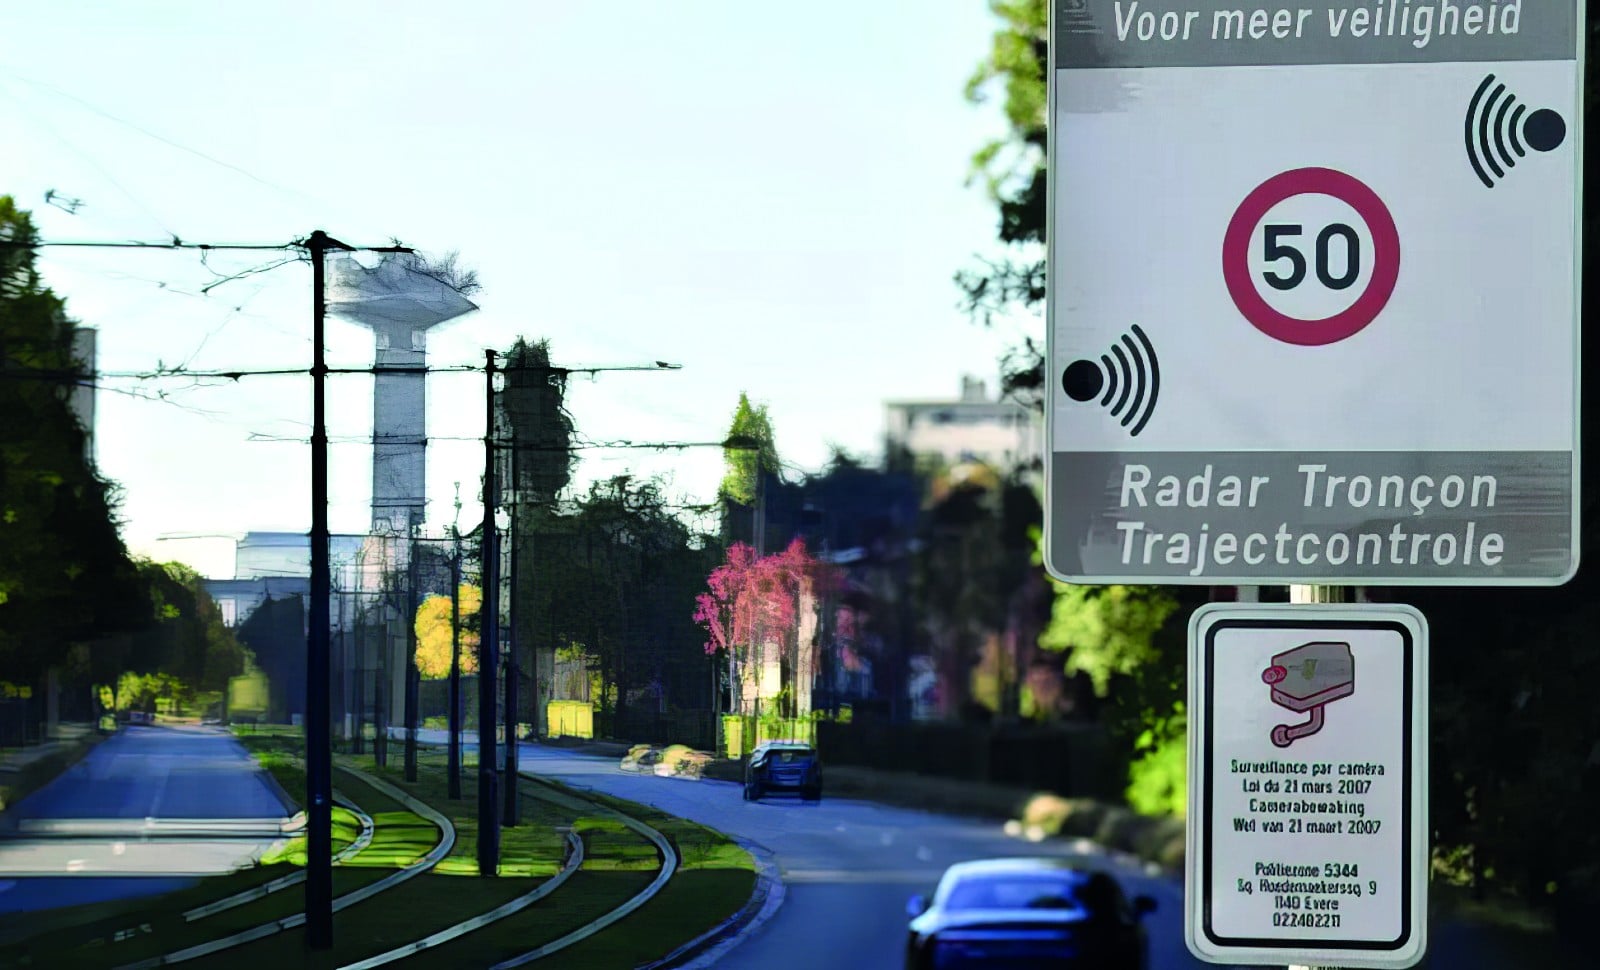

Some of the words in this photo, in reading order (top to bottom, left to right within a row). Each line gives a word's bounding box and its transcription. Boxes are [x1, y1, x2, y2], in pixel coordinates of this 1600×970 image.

[1114, 1, 1200, 42] Voor
[1211, 4, 1312, 40] meer
[1329, 0, 1522, 48] veiligheid
[1263, 223, 1360, 291] 50
[1120, 464, 1270, 508] Radar
[1298, 464, 1498, 515] Tronçon
[1116, 521, 1505, 576] Trajectcontrole
[1312, 764, 1332, 776] par
[1284, 779, 1298, 793] 21
[1302, 781, 1333, 794] mars
[1337, 780, 1372, 794] 2007
[1262, 821, 1283, 833] van
[1288, 819, 1302, 834] 21
[1347, 820, 1382, 835] 2007
[1304, 896, 1339, 910] Evere
